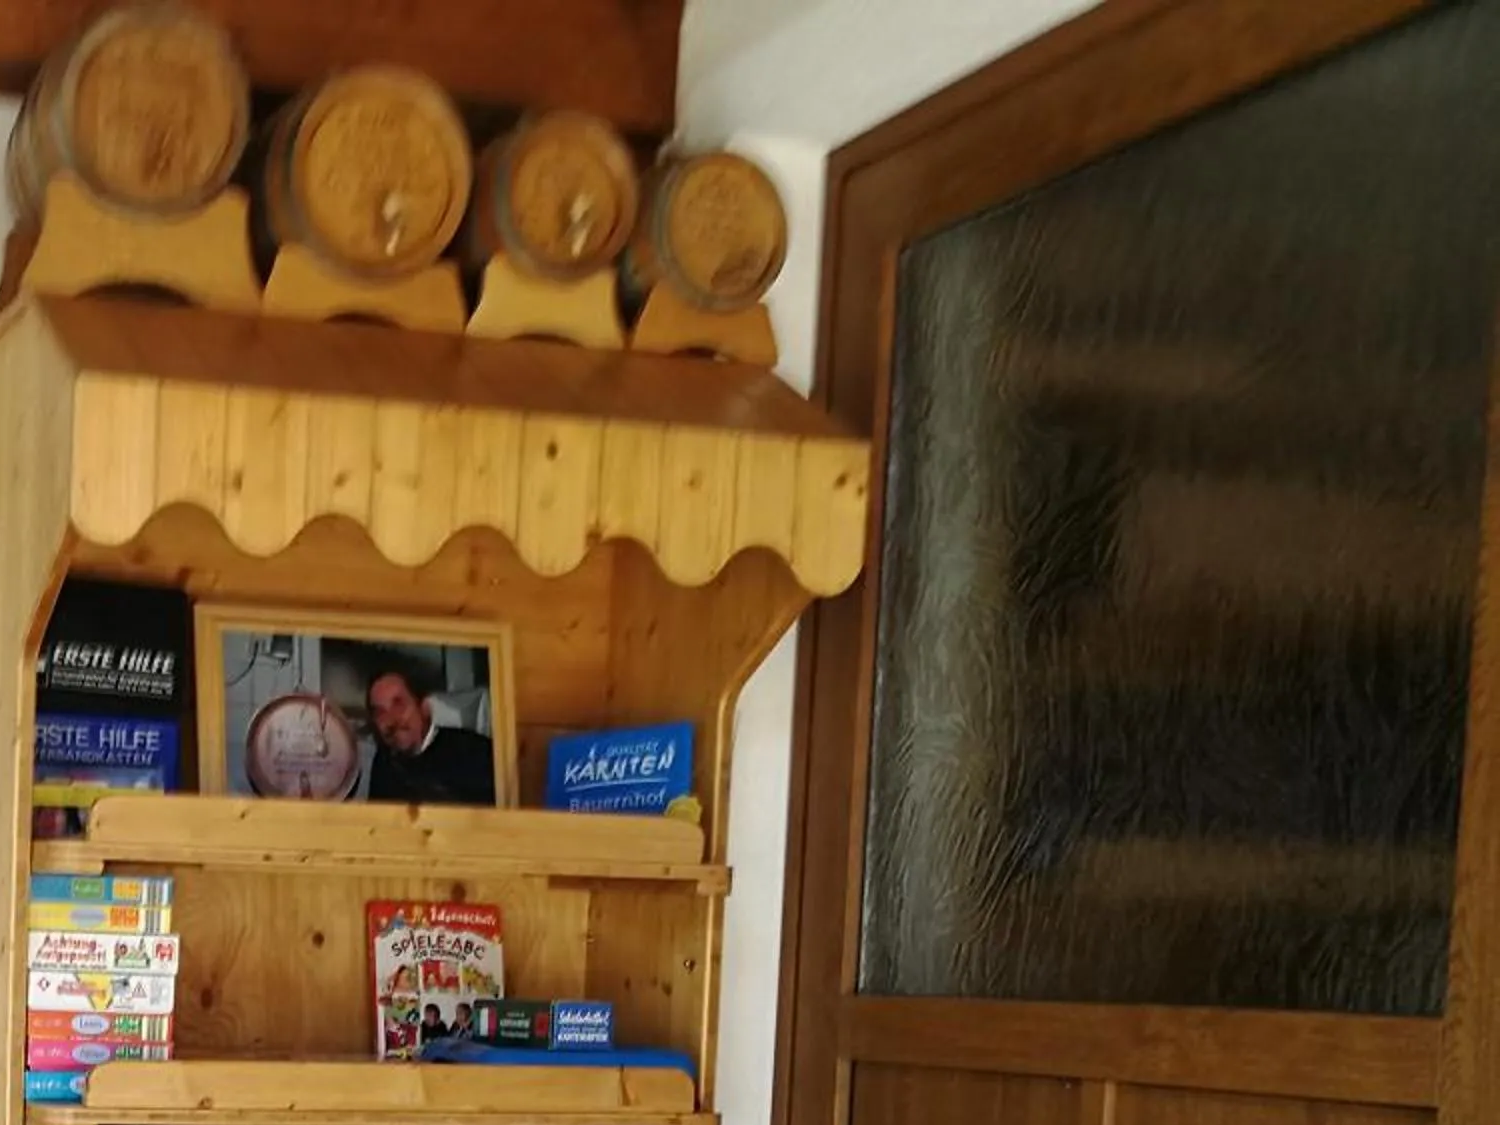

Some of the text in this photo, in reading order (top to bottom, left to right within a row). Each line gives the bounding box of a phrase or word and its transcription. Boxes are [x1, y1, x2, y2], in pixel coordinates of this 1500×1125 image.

[53, 643, 175, 674] ERSTE HILFE
[35, 725, 161, 751] RSTE HILFE
